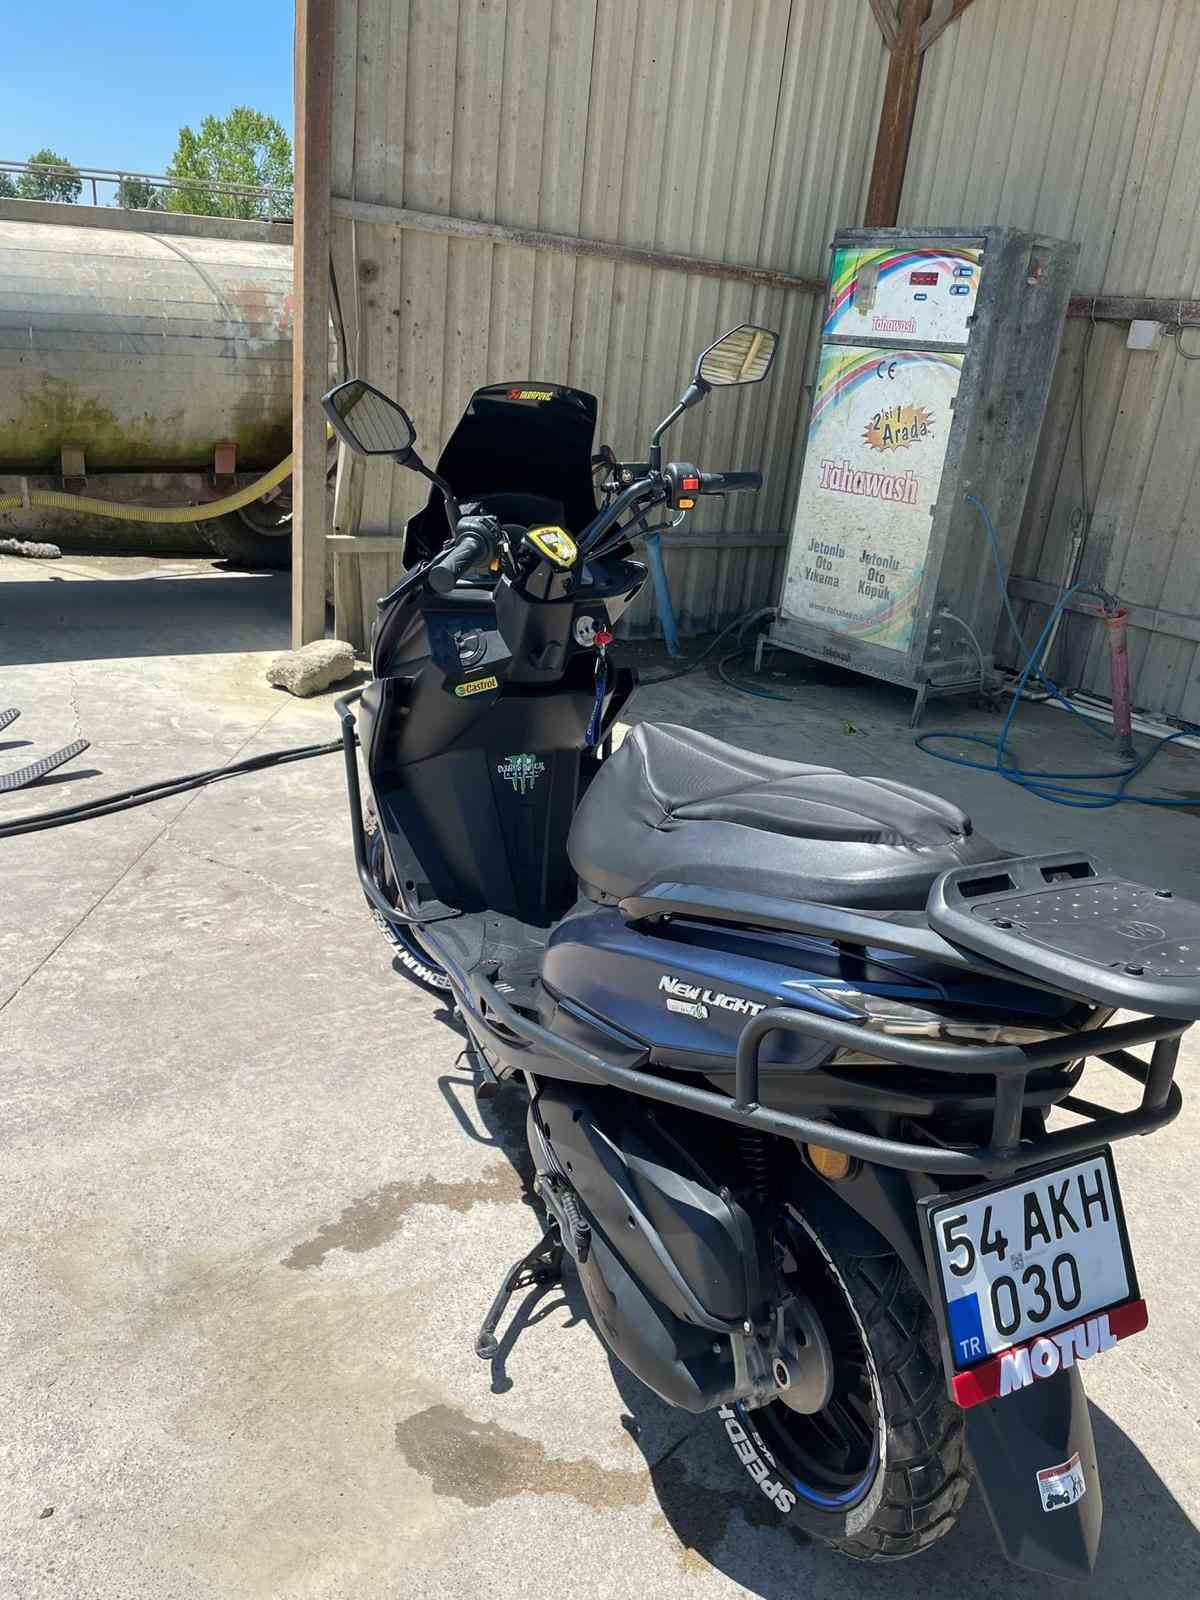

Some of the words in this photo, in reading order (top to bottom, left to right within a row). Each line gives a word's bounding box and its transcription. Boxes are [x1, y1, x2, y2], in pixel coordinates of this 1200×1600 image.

[819, 459, 919, 505] Tahawash
[807, 537, 846, 559] Jetonlu
[815, 555, 833, 571] Oto
[867, 567, 886, 585] Oto
[466, 678, 496, 693] Castrol
[701, 989, 768, 1017] LIGHT
[941, 1205, 1009, 1278] 54
[1022, 1168, 1110, 1251] AKH
[989, 1252, 1082, 1337] 030
[959, 1336, 982, 1360] TR
[999, 1313, 1118, 1397] MOTUL
